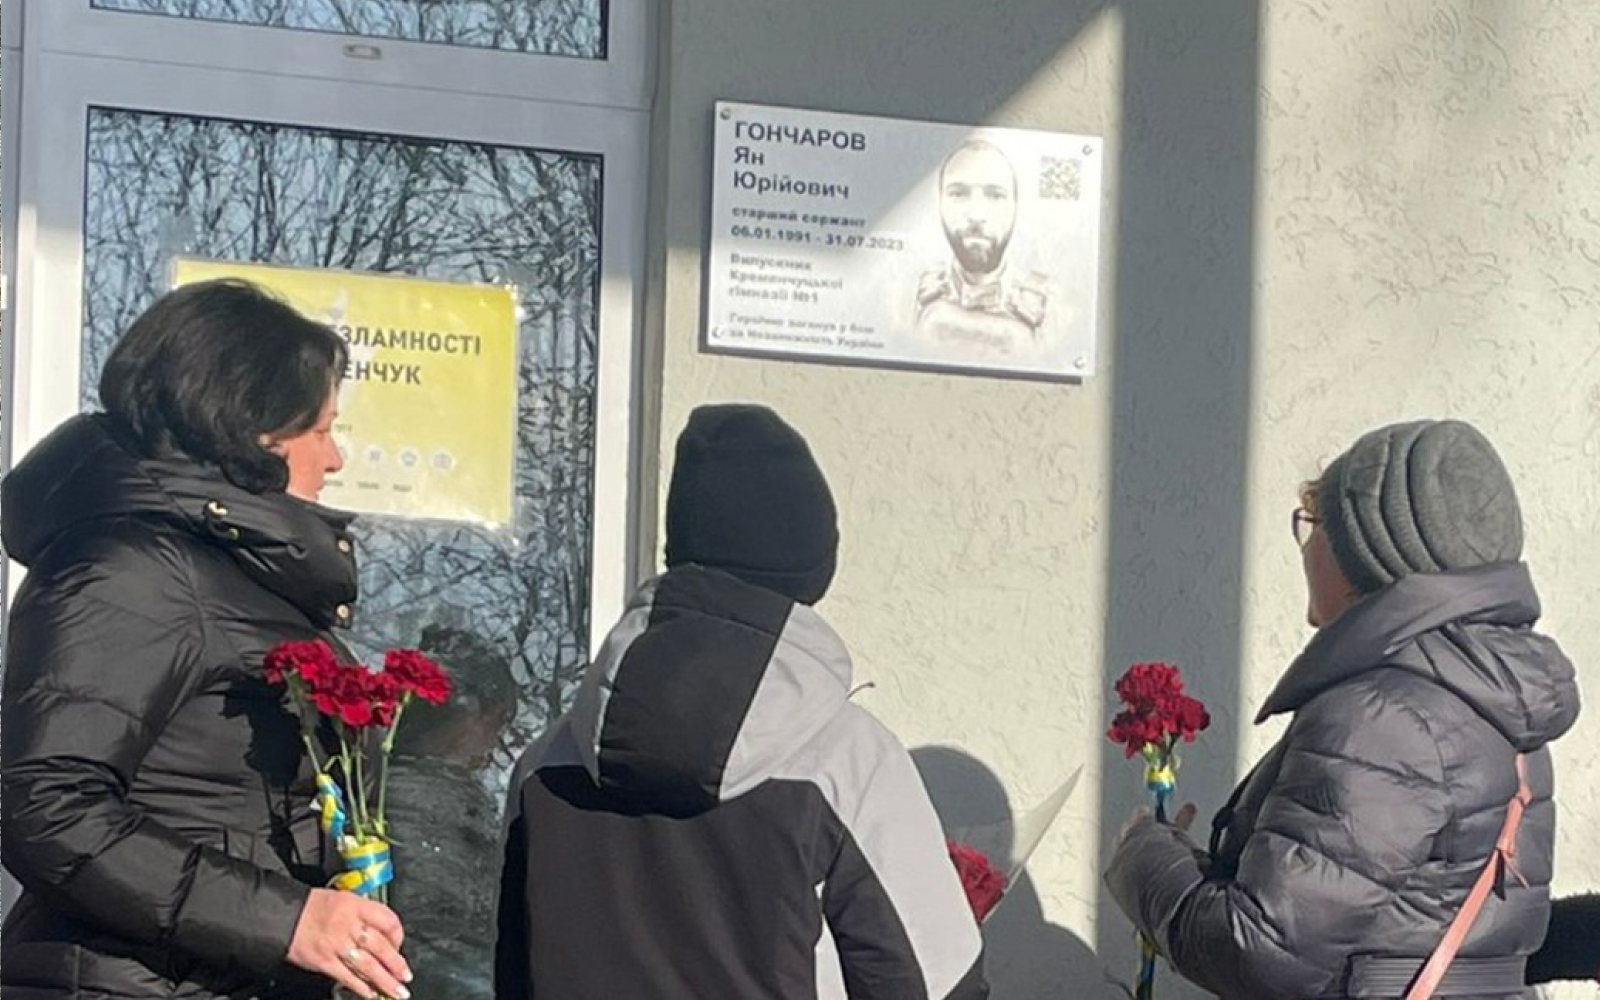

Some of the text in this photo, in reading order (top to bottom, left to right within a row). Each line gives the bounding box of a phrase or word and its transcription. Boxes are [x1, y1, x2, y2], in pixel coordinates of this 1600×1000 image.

[735, 121, 867, 151] ГОНЧАРОВ
[734, 146, 764, 166] Ян
[733, 170, 849, 200] Юрійович
[732, 207, 866, 228] старший сержант
[731, 225, 811, 243] 06.01.1991
[825, 233, 904, 251] 31.07.2023
[332, 324, 481, 356] ЗЛАМНОСТІ
[344, 360, 421, 385] ЕНЧУК
